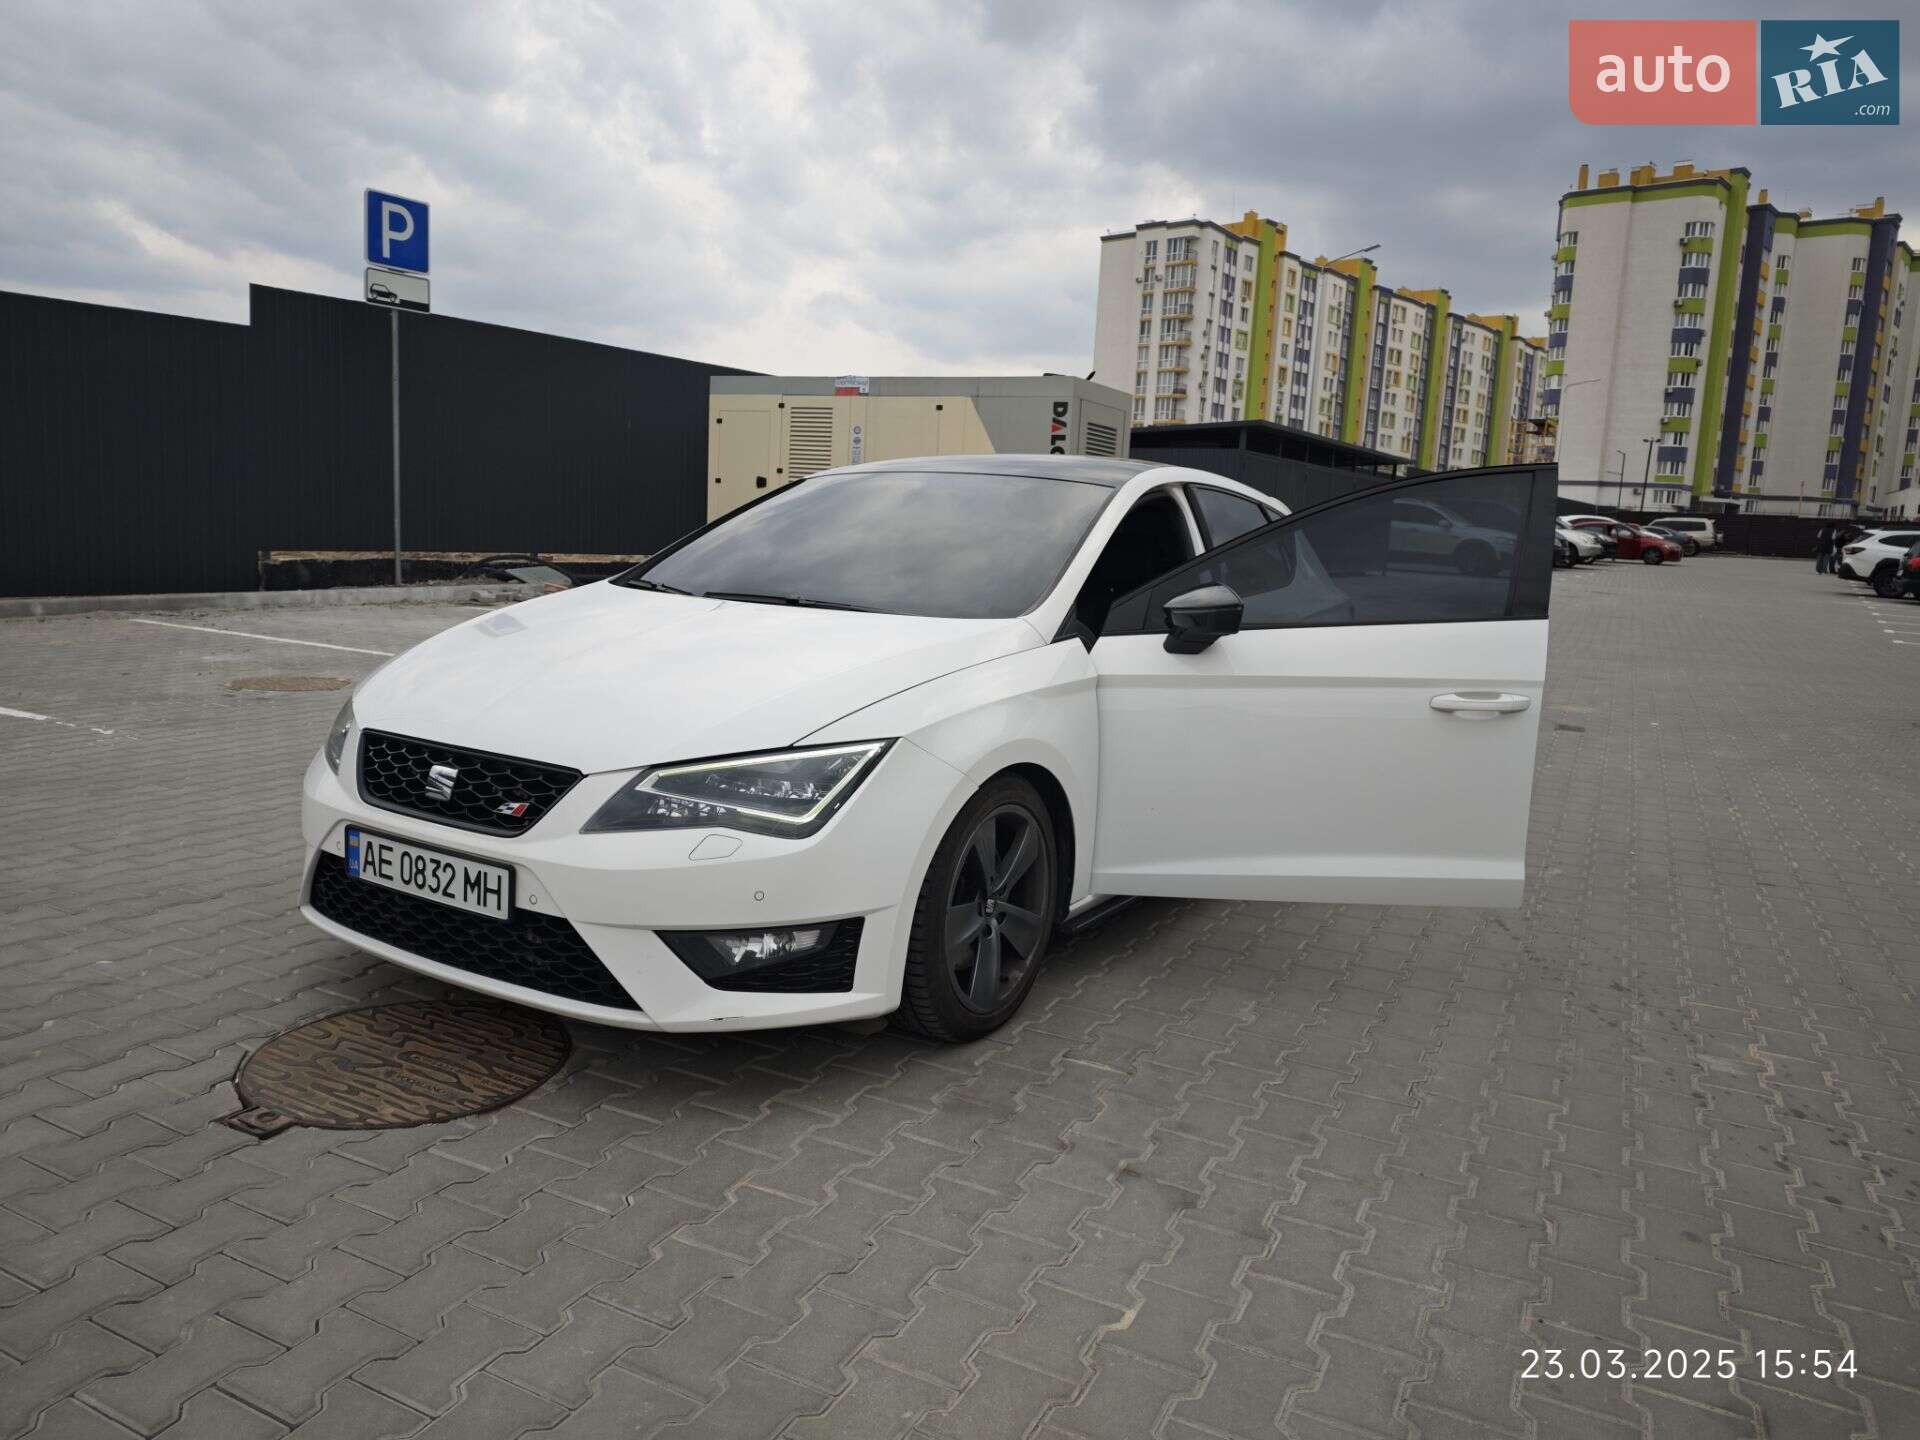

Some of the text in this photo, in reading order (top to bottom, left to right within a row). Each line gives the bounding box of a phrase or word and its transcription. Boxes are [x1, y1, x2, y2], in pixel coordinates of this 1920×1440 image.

[381, 200, 415, 259] P
[362, 840, 502, 911] AE 0832 MH
